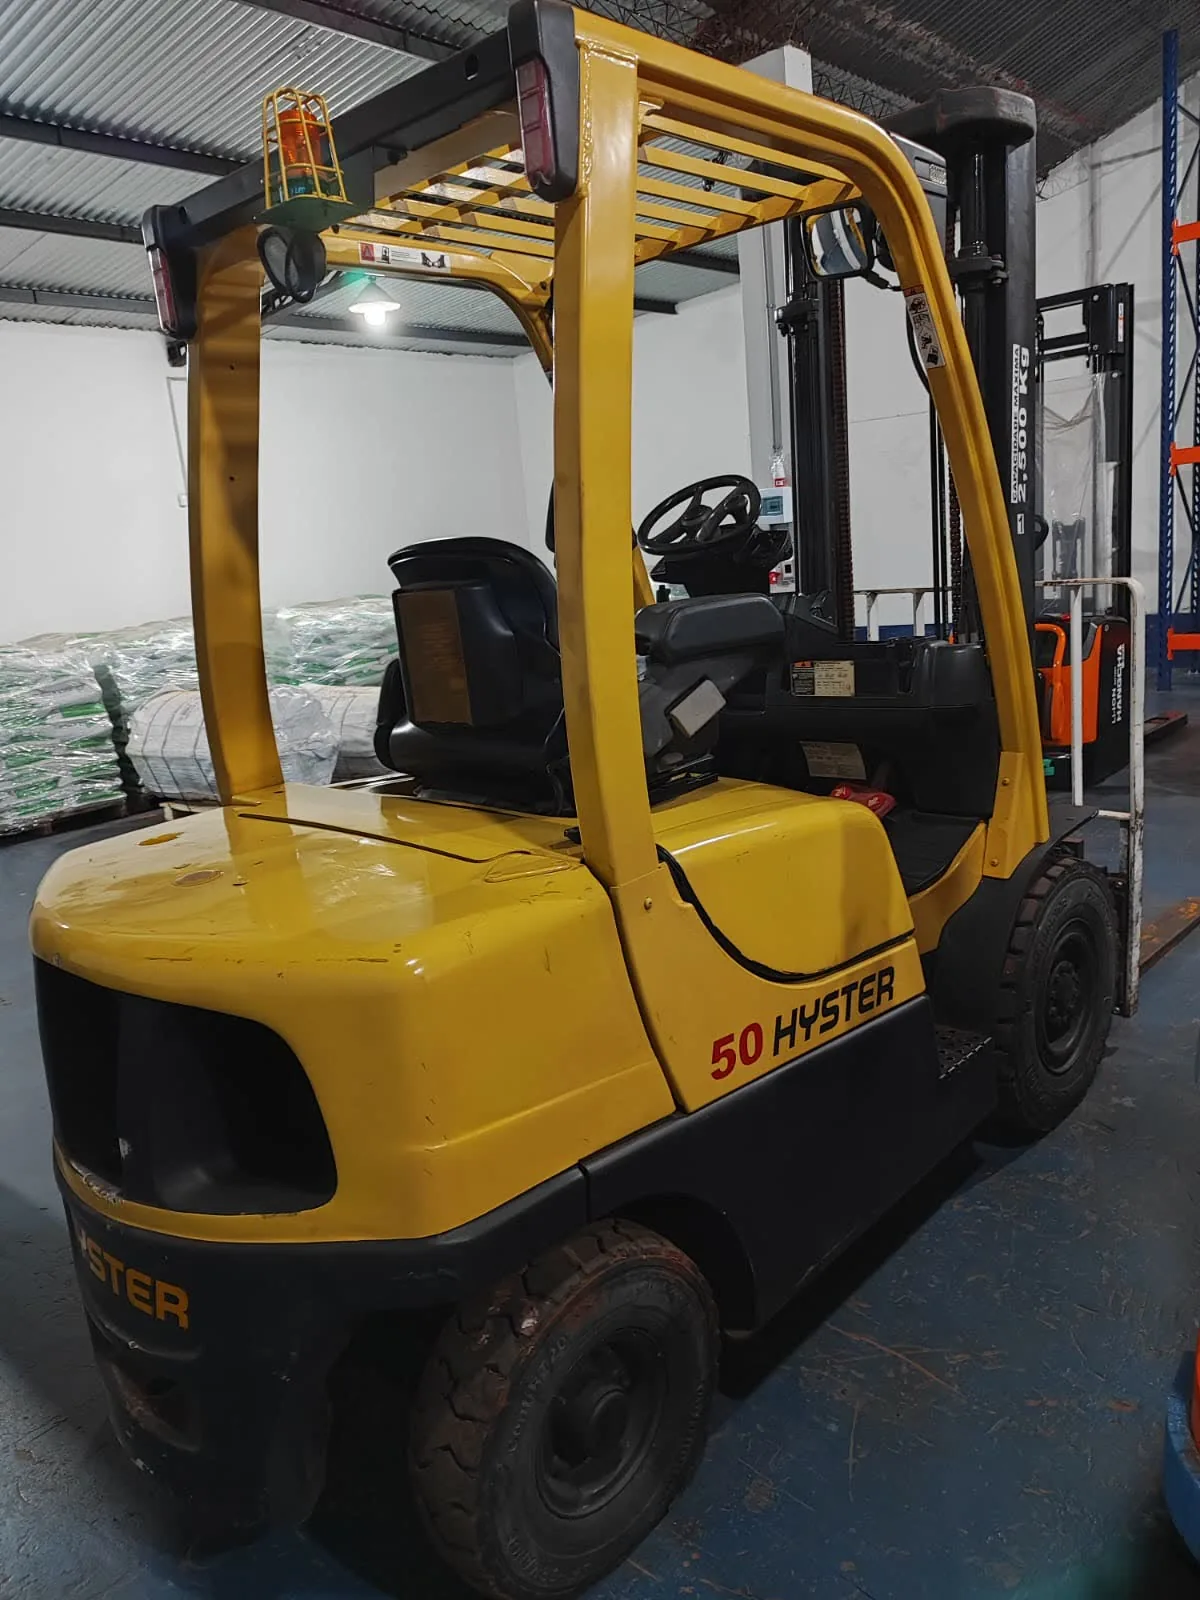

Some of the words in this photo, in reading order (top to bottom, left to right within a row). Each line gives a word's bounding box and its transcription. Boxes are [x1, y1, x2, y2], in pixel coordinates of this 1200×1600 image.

[1019, 346, 1029, 394] Kg
[711, 1022, 764, 1080] 50
[773, 966, 895, 1056] HYSTER
